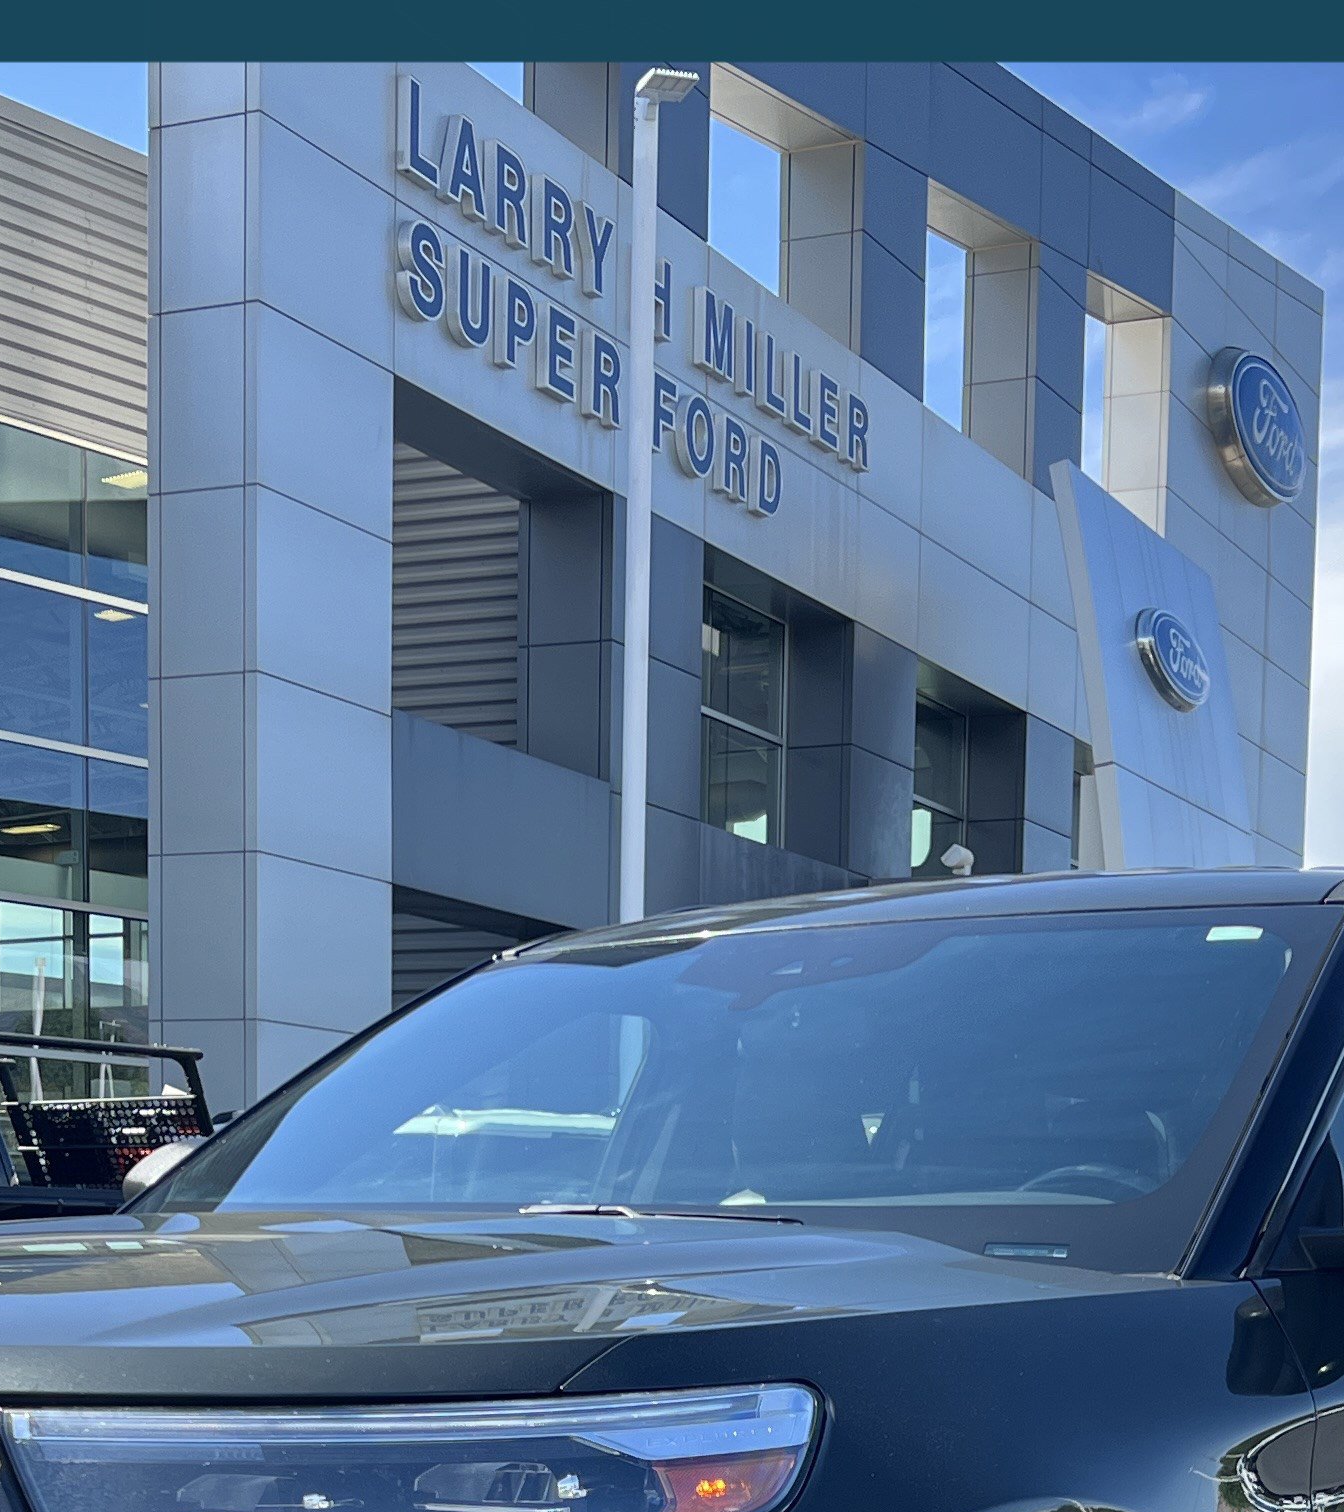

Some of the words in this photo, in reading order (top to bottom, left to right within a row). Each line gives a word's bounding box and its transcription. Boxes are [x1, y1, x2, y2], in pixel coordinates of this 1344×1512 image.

[398, 75, 616, 297] LARRY
[694, 286, 869, 473] MILLER
[398, 220, 620, 428] SUPER
[652, 370, 783, 517] FORD
